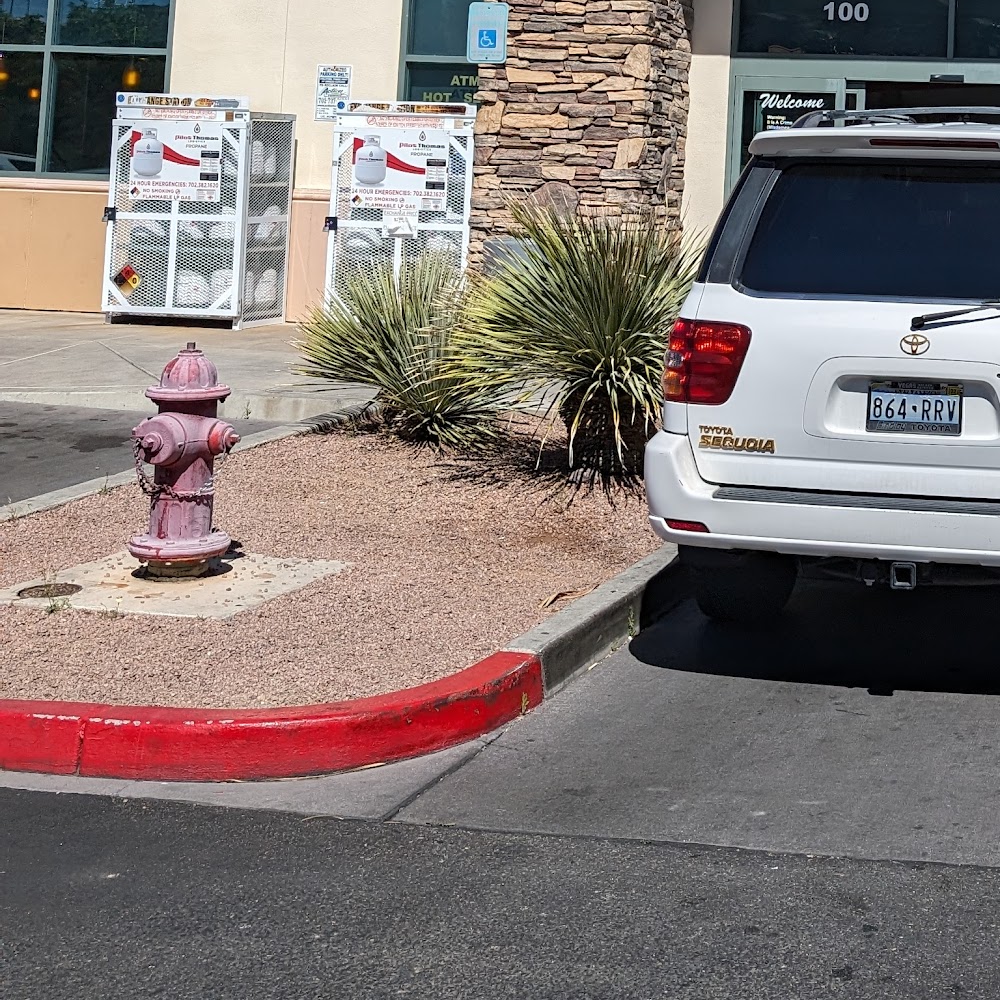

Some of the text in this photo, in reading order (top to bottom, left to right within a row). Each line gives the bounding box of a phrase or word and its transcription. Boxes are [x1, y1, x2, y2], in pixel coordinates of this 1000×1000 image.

[823, 1, 869, 22] 100
[450, 75, 480, 86] ATM
[422, 92, 453, 103] HOT
[760, 93, 825, 109] Welcome
[873, 397, 956, 422] 864 RRV
[698, 424, 733, 435] TOYOTA
[911, 423, 952, 432] TOYOTA
[698, 435, 775, 454] SEQUOIA
